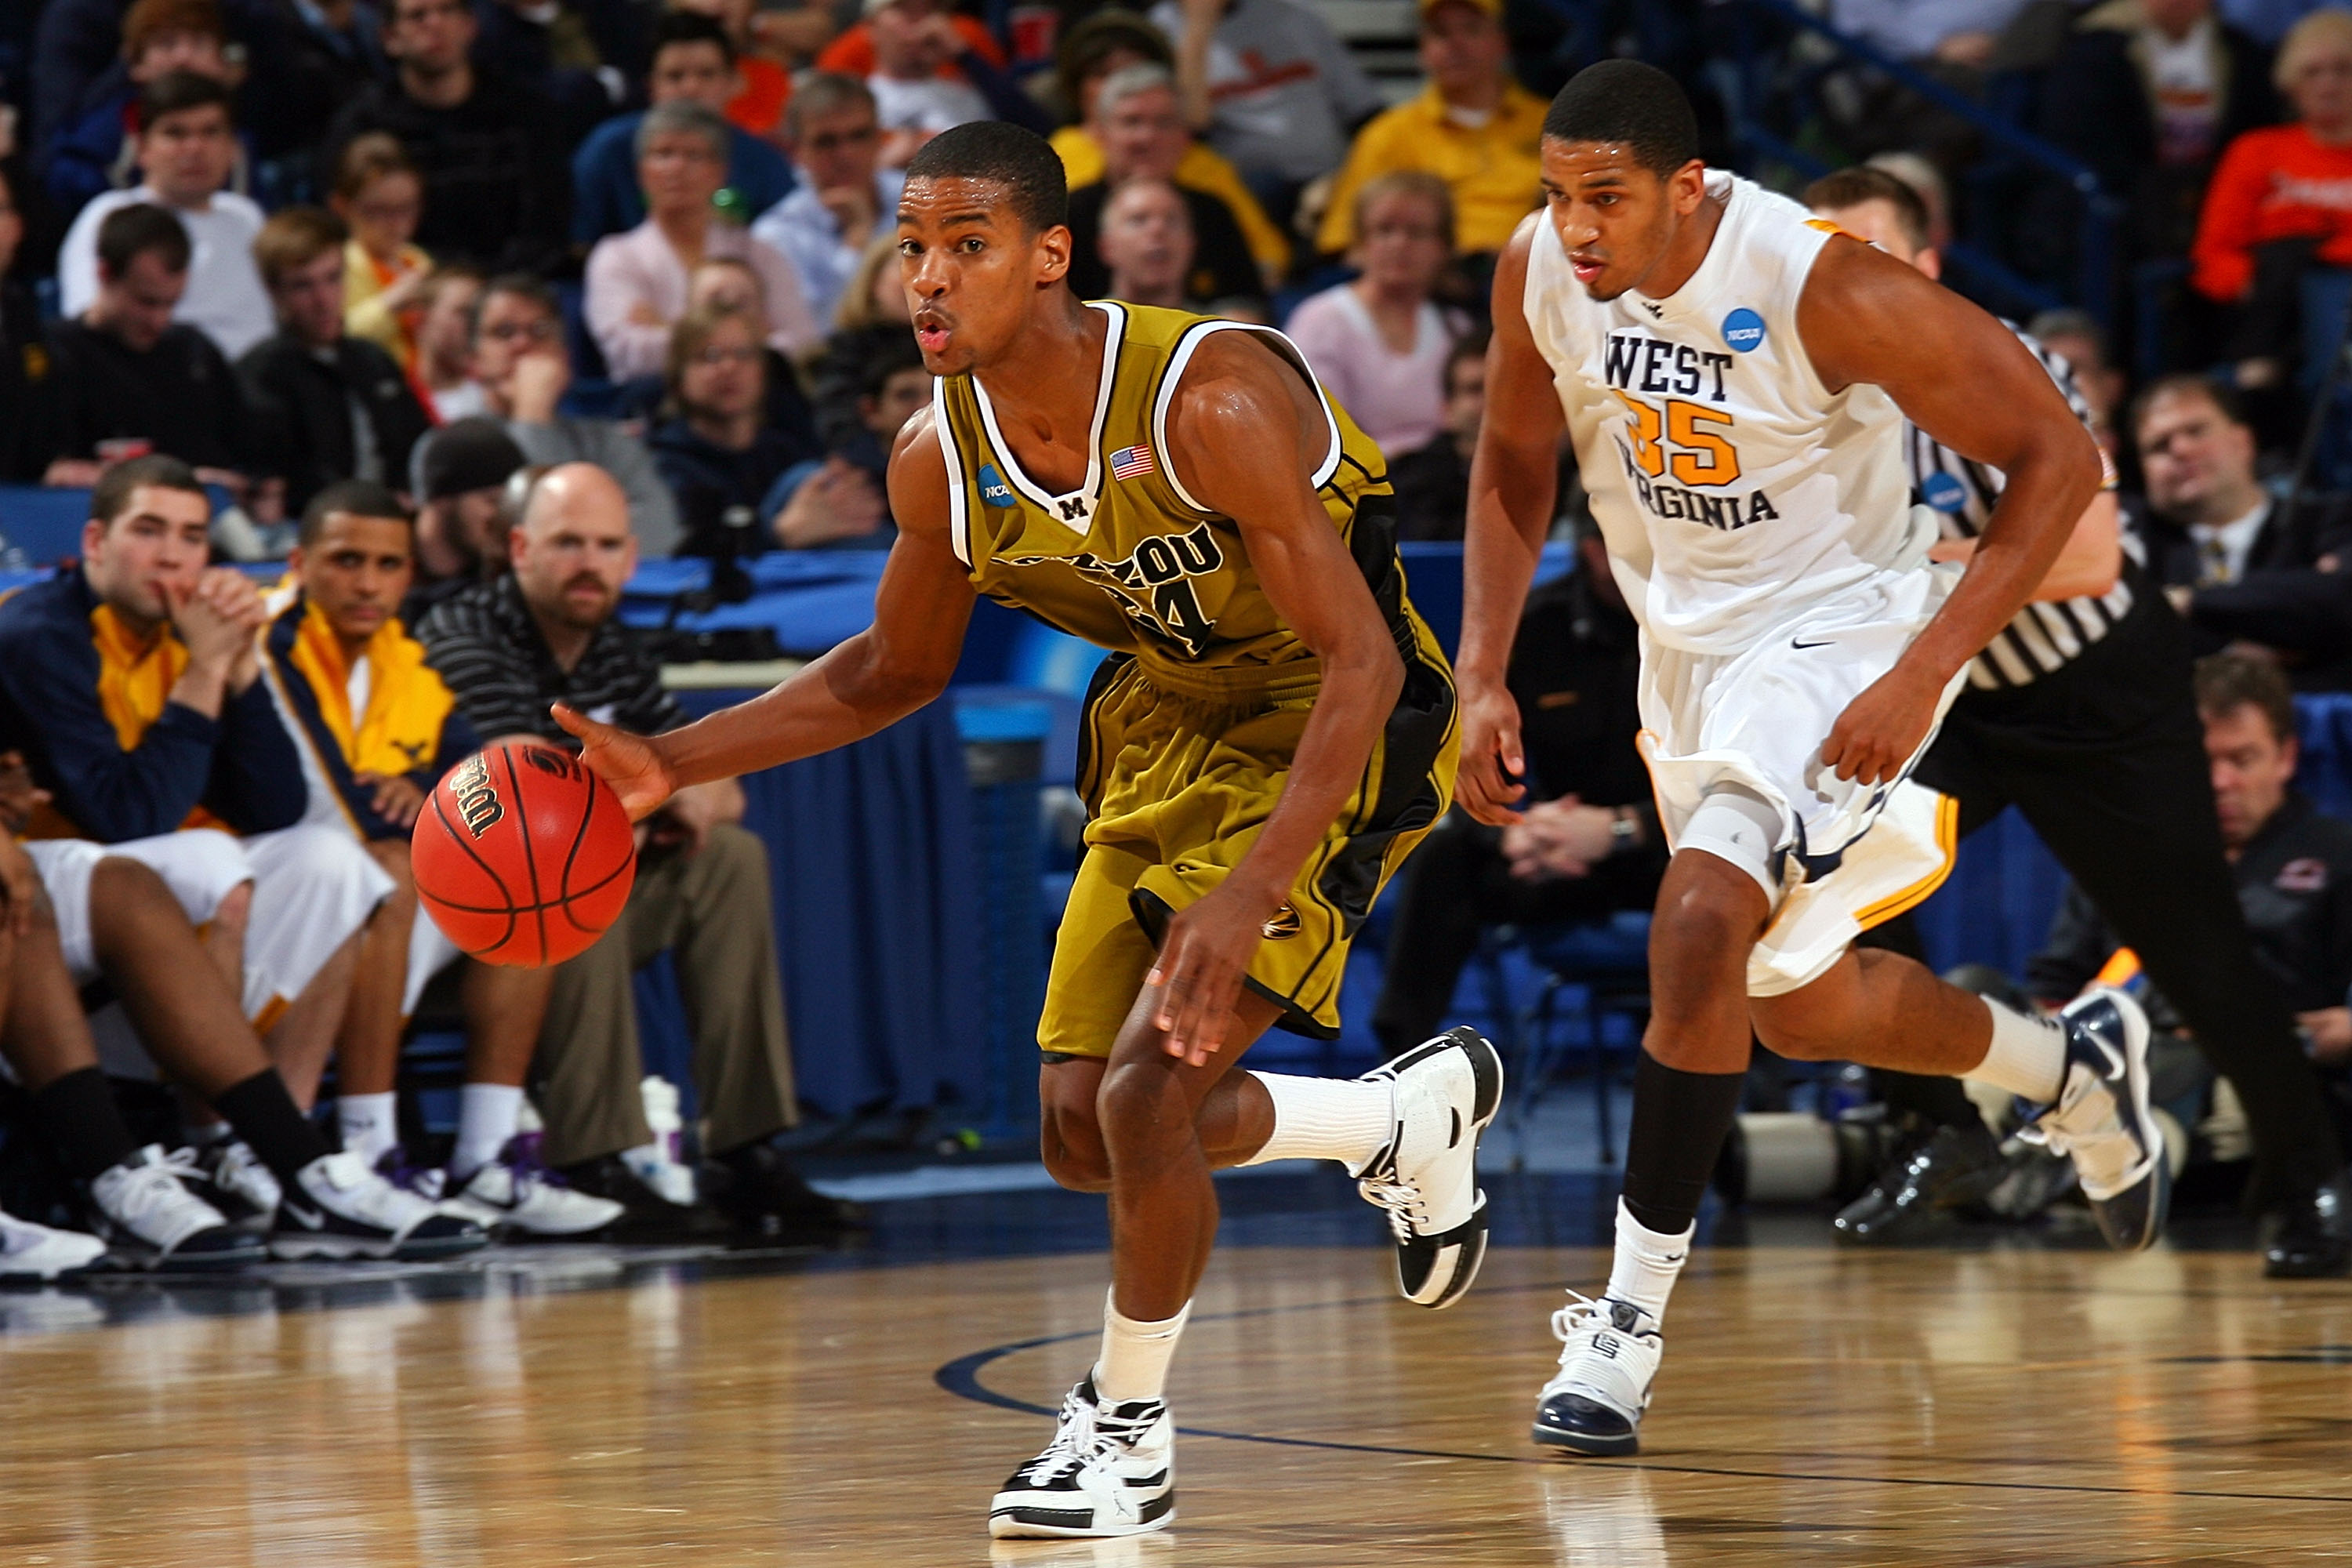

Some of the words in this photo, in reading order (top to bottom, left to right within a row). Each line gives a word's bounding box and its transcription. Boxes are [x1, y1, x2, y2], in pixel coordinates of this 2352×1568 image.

[1606, 332, 1733, 402] WEST
[985, 484, 1011, 499] NCA
[1057, 496, 1089, 521] M
